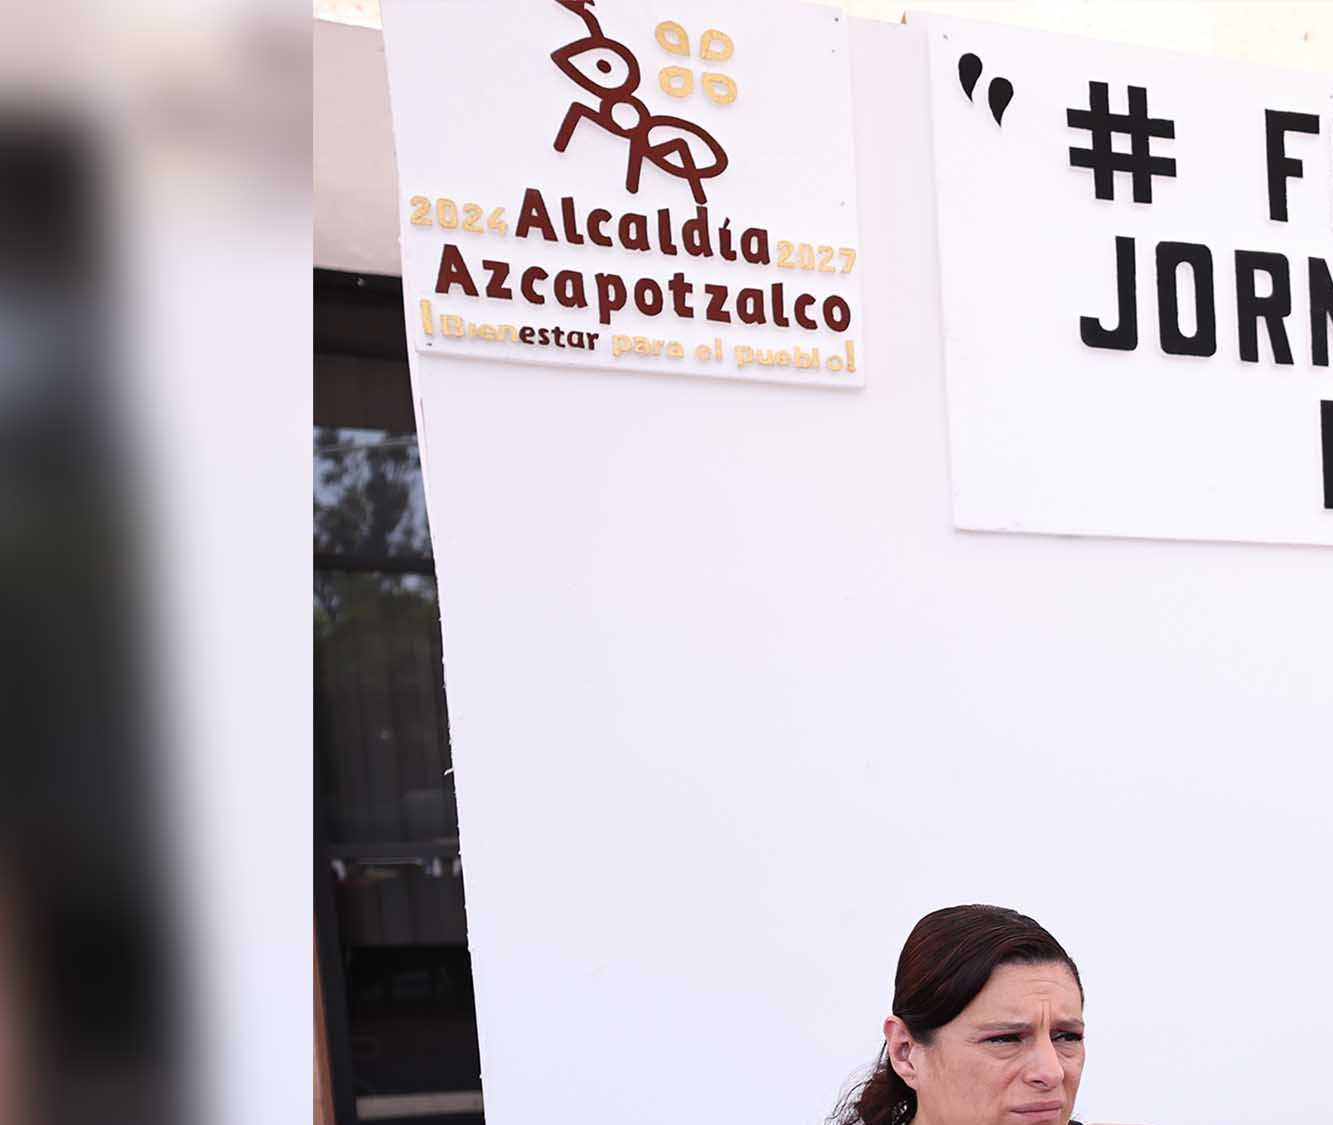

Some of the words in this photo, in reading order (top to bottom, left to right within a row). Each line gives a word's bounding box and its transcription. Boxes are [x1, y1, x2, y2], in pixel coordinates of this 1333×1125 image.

[410, 195, 508, 236] 2024
[515, 188, 771, 266] Alcaldía
[776, 240, 857, 273] 2027
[434, 243, 851, 333] Azcapotzalco
[612, 334, 685, 358] para
[695, 337, 722, 362] el
